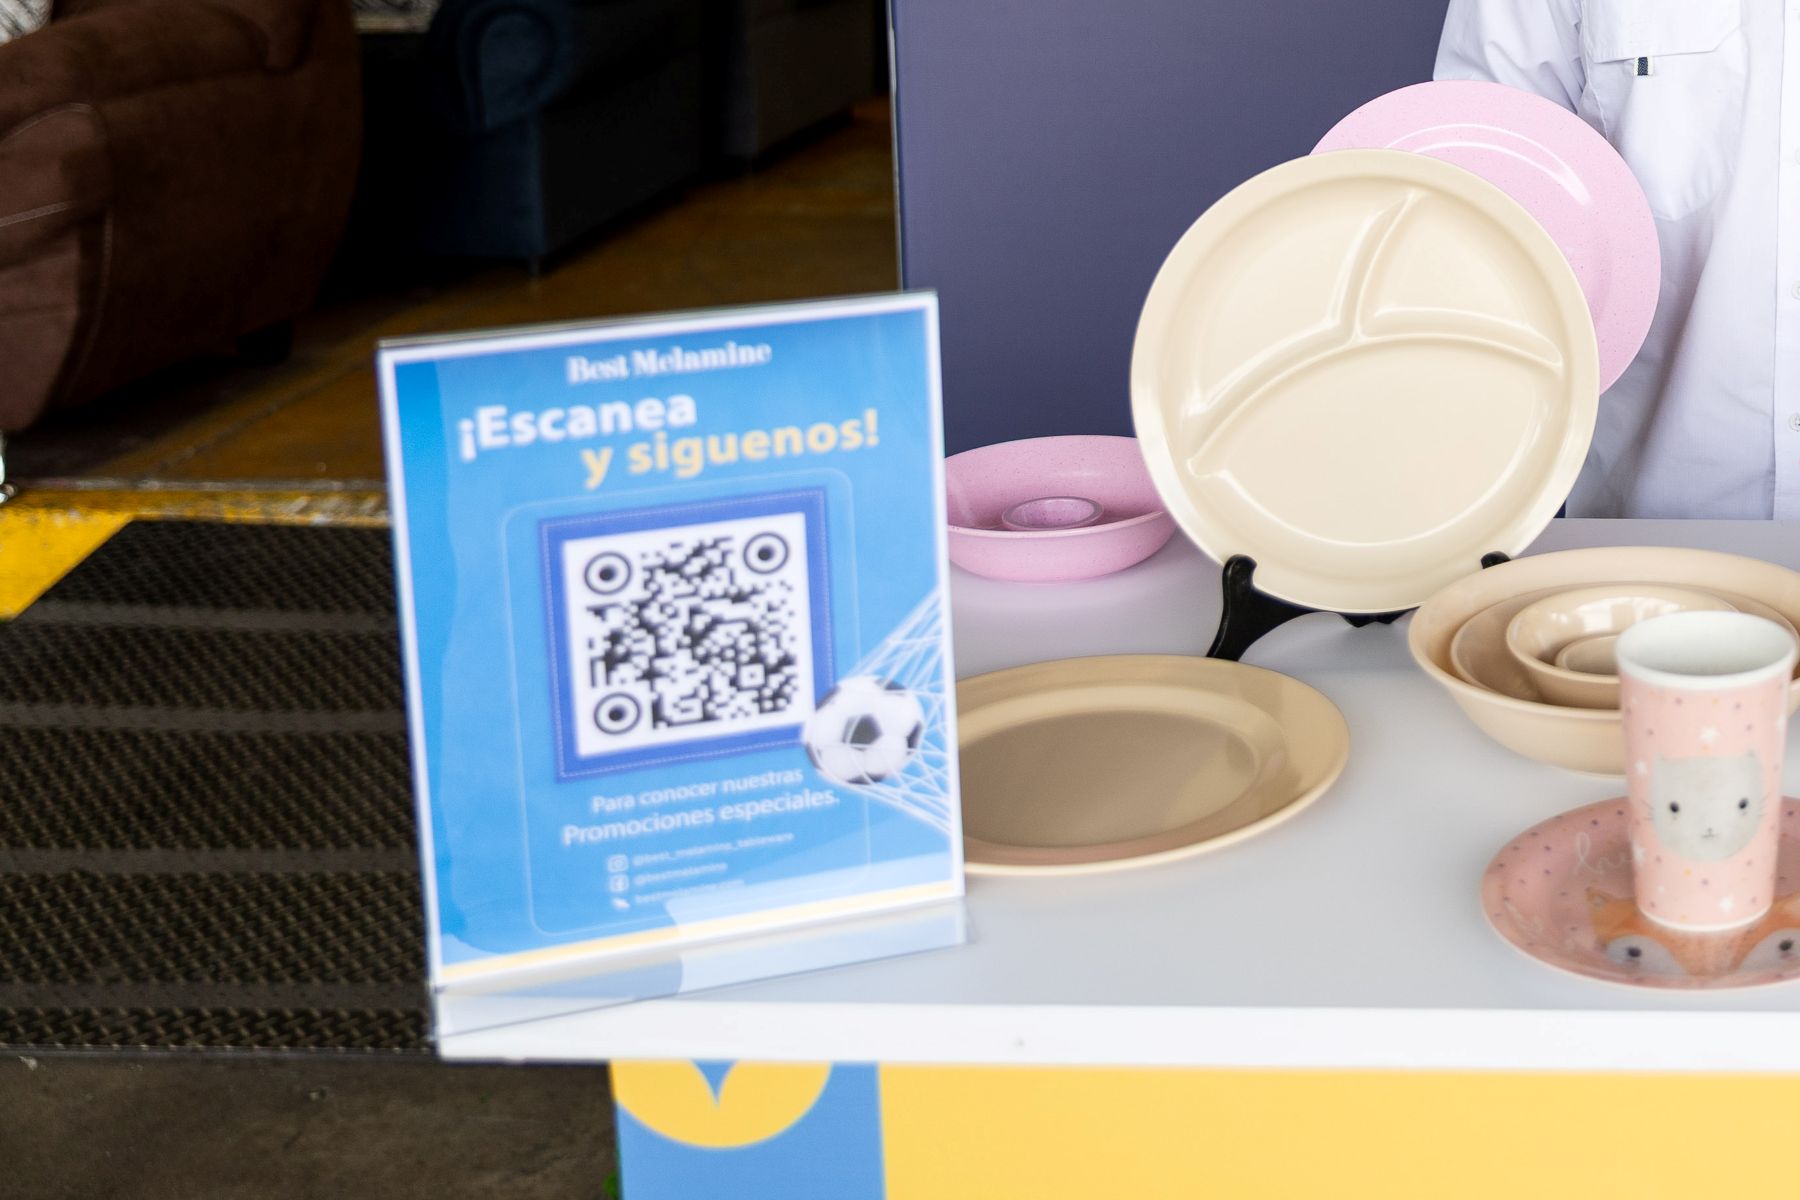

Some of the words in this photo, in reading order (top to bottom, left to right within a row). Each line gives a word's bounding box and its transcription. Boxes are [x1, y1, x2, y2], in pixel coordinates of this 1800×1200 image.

[566, 353, 629, 385] Best
[632, 341, 772, 378] Melamine
[457, 392, 698, 462] ¡Escanea
[581, 446, 613, 491] y
[591, 792, 636, 814] Para
[639, 781, 718, 807] conocer
[722, 768, 804, 794] nuestras
[562, 806, 715, 847] Promociones
[719, 788, 840, 823] especiales.
